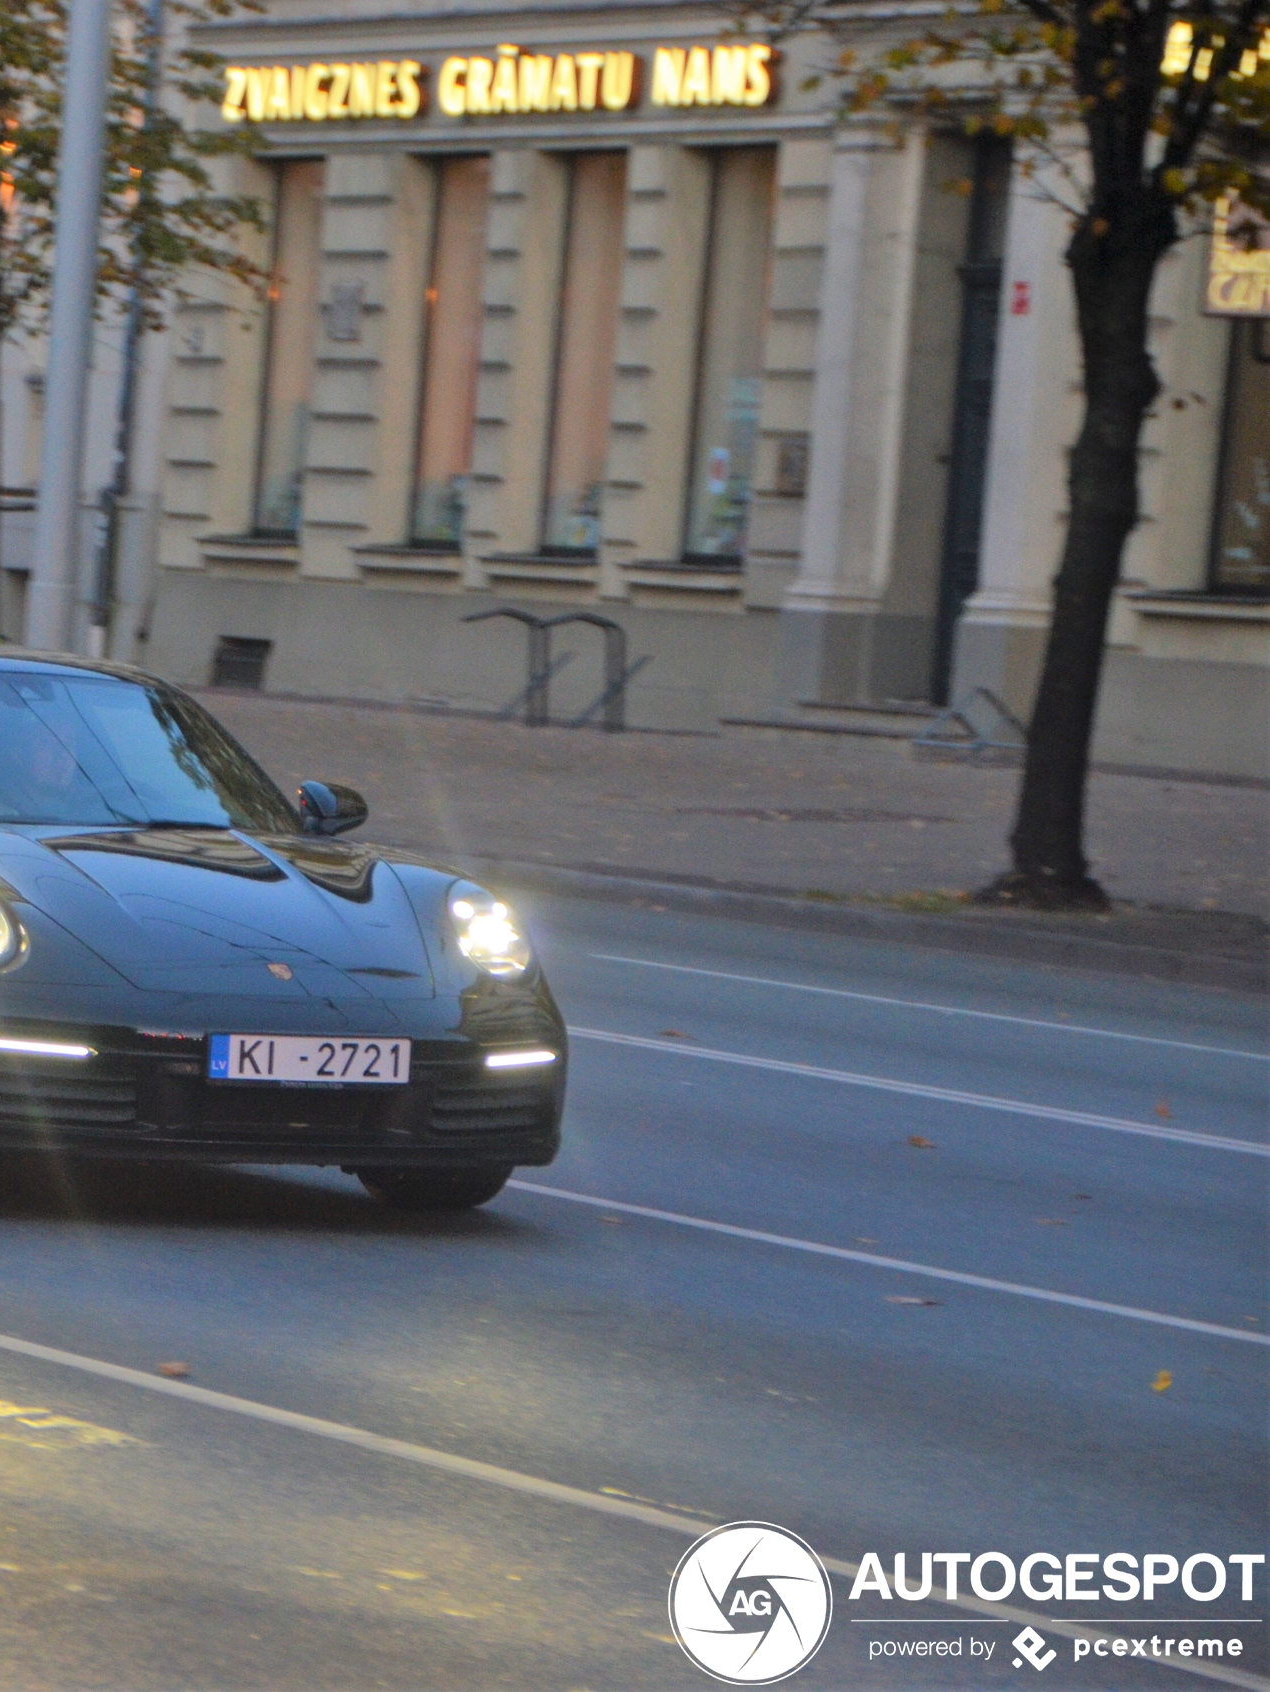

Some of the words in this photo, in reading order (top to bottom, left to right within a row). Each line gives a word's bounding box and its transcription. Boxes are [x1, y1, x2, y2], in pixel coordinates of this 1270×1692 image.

[438, 43, 634, 116] GRĀMATU
[651, 43, 771, 106] NAMS
[212, 1060, 227, 1070] LV
